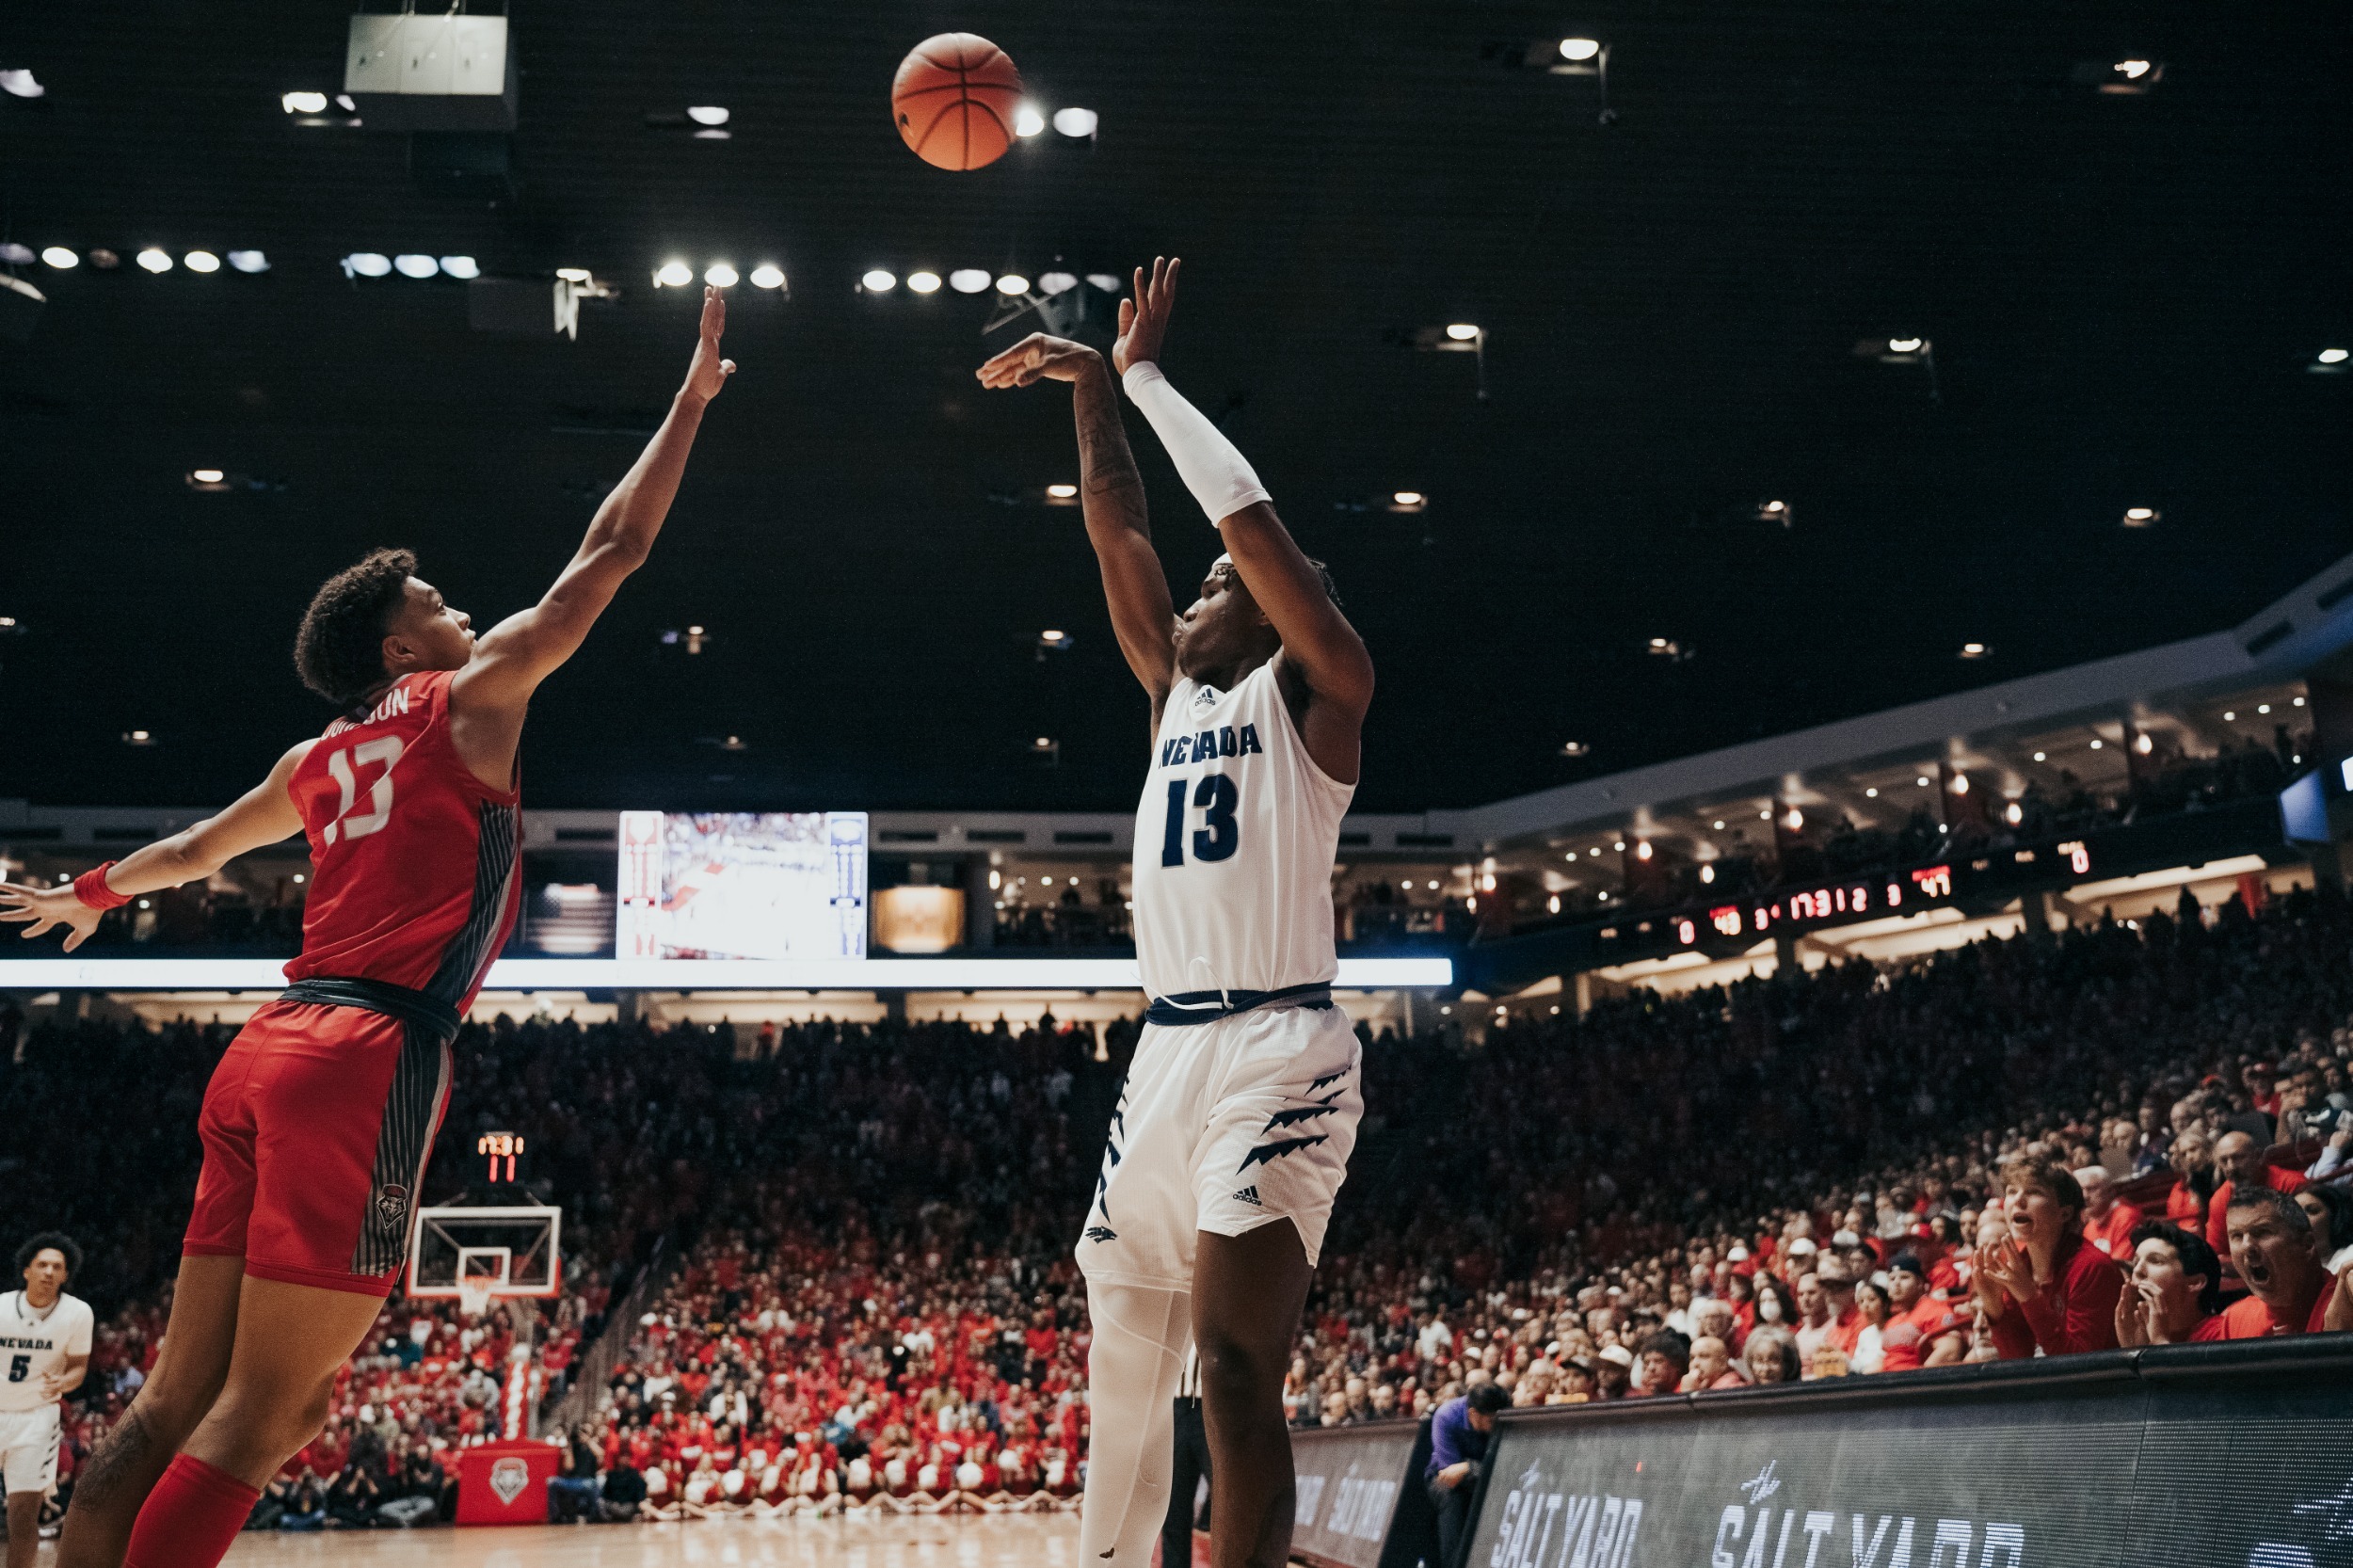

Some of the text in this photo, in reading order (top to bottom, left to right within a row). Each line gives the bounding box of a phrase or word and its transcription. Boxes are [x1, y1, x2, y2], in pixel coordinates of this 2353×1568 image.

[1159, 723, 1263, 770] NEVADA
[324, 734, 405, 847] 13
[1160, 771, 1240, 870] 13
[2072, 848, 2089, 874] 0
[488, 1154, 516, 1183] 11
[1232, 1193, 1262, 1207] adidas
[0, 1336, 53, 1350] NEVADA
[8, 1354, 32, 1383] 5
